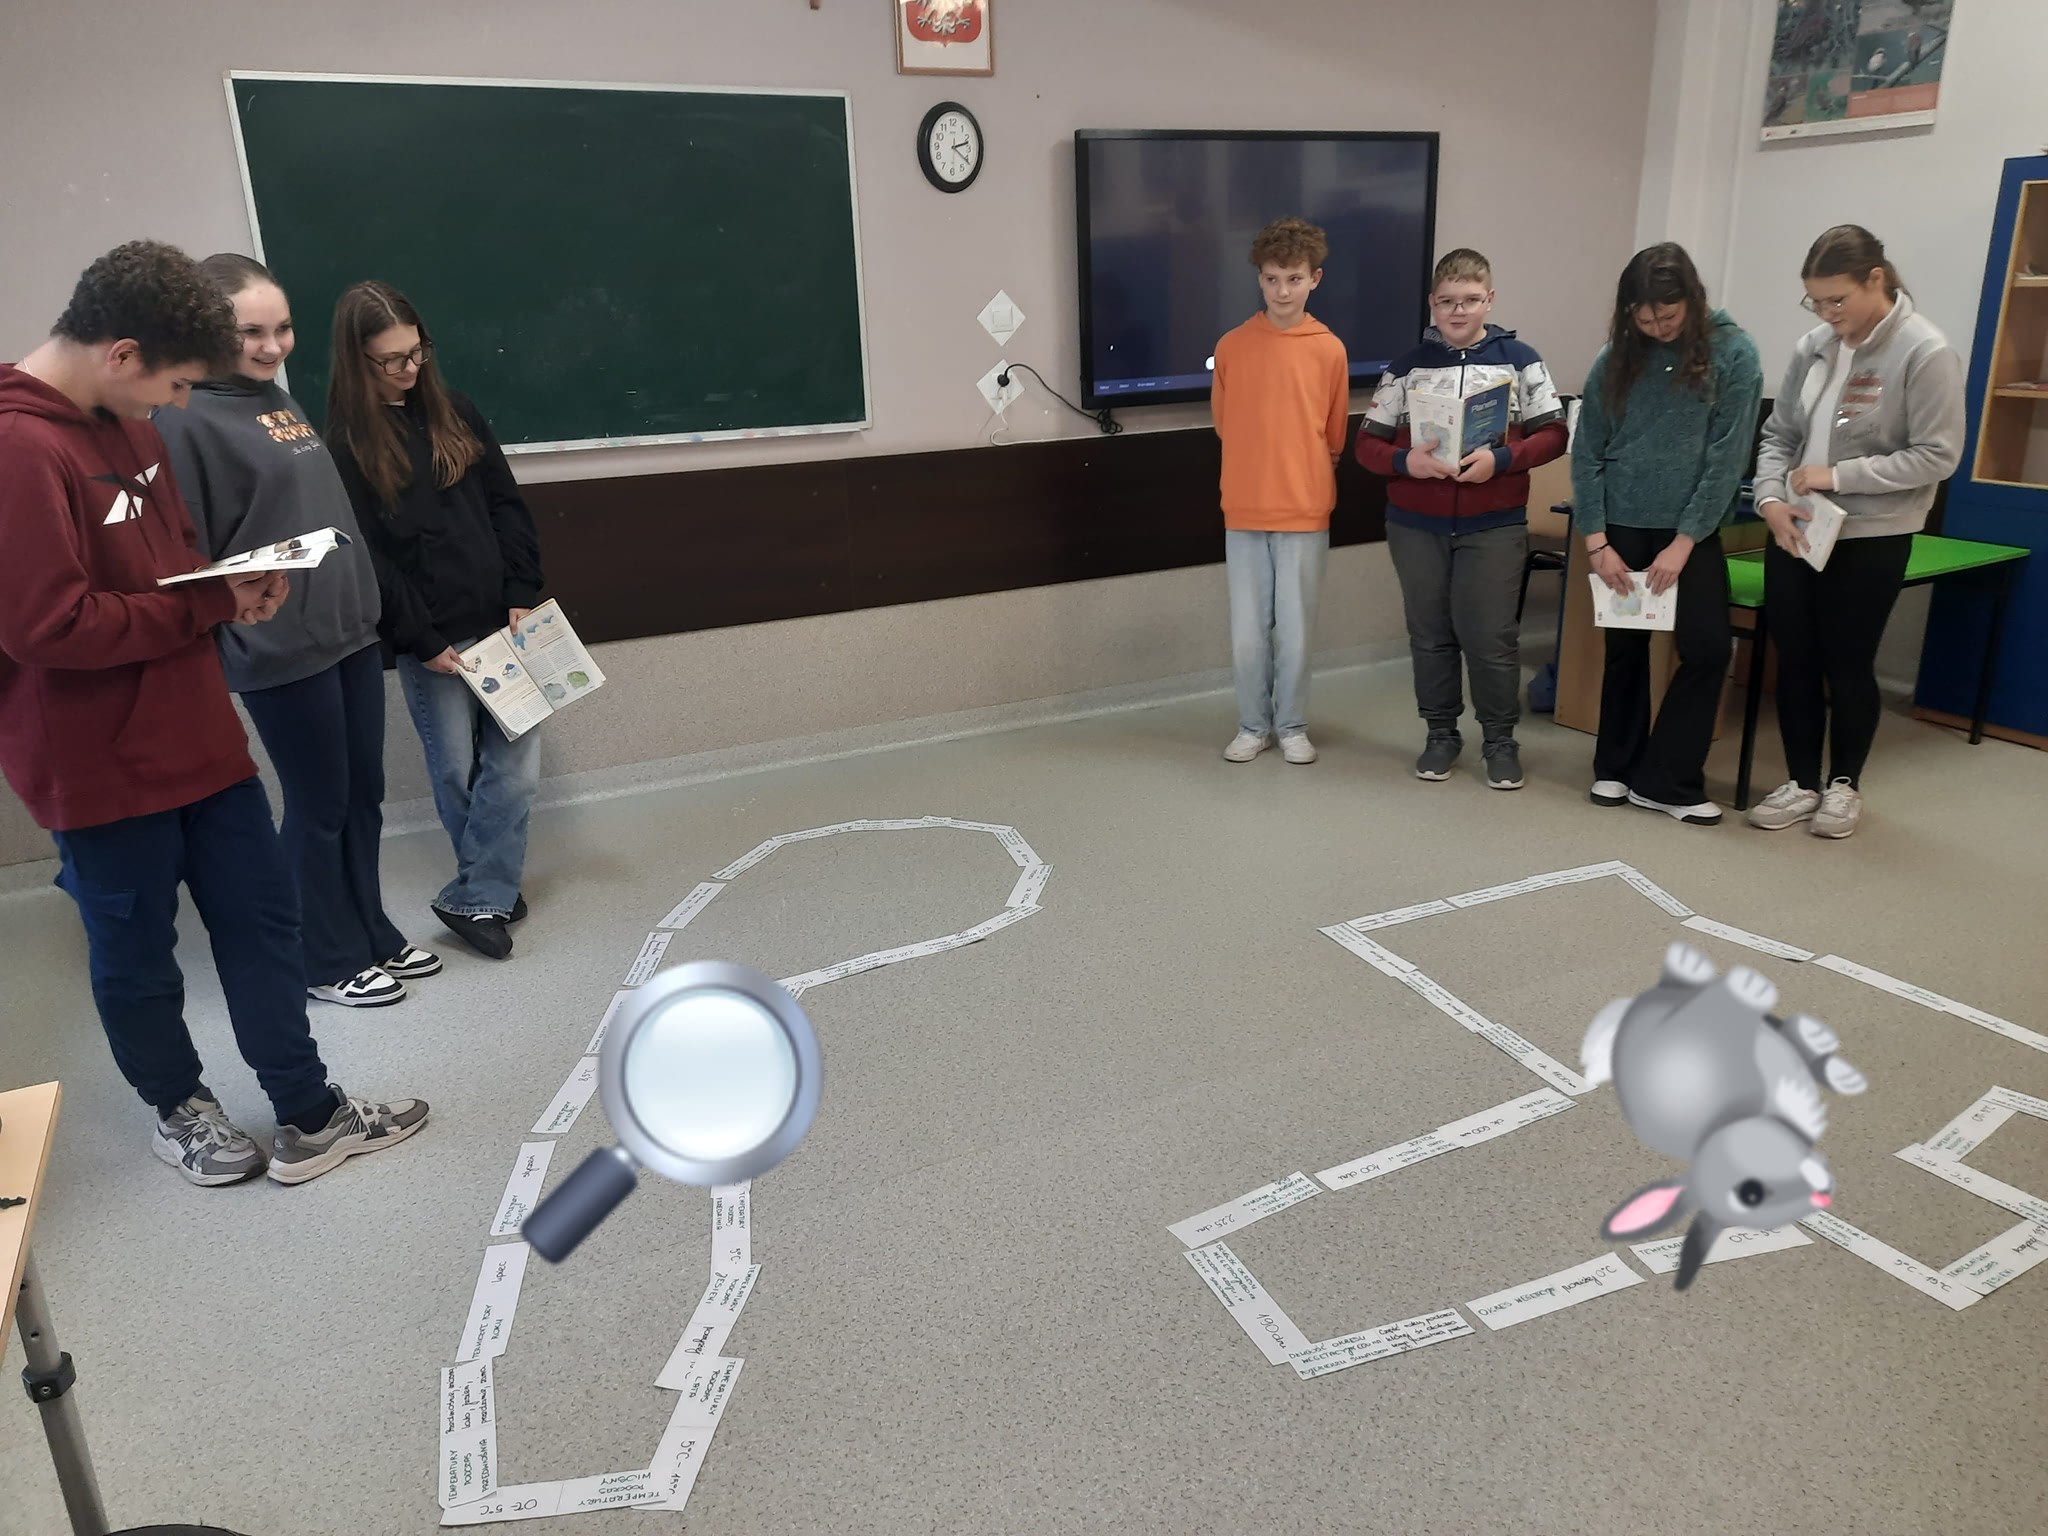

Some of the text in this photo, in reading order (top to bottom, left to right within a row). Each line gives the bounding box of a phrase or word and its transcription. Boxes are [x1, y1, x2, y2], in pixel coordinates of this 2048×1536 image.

[949, 117, 957, 126] 12
[940, 123, 947, 131] 11
[935, 132, 944, 141] 10
[964, 133, 970, 141] 2
[933, 142, 940, 150] 9
[965, 145, 972, 153] 3
[935, 152, 941, 160] 8
[941, 162, 946, 170] 7
[959, 164, 965, 172] 5
[949, 167, 955, 176] 6
[705, 1272, 728, 1304] JESIENI
[729, 1262, 756, 1312] TEMPERATURY
[491, 1319, 504, 1340] ROKU
[689, 1376, 702, 1398] LATA
[708, 1361, 736, 1415] TEMPERATURY
[463, 1452, 472, 1486] PODCZAS
[478, 1439, 490, 1493] PRZEDWIOŚNIA
[448, 1450, 458, 1502] TEMPERATURY
[600, 1472, 651, 1486] WIOSNY
[598, 1484, 644, 1494] PODCZAS
[578, 1491, 660, 1506] TEMPERATURY
